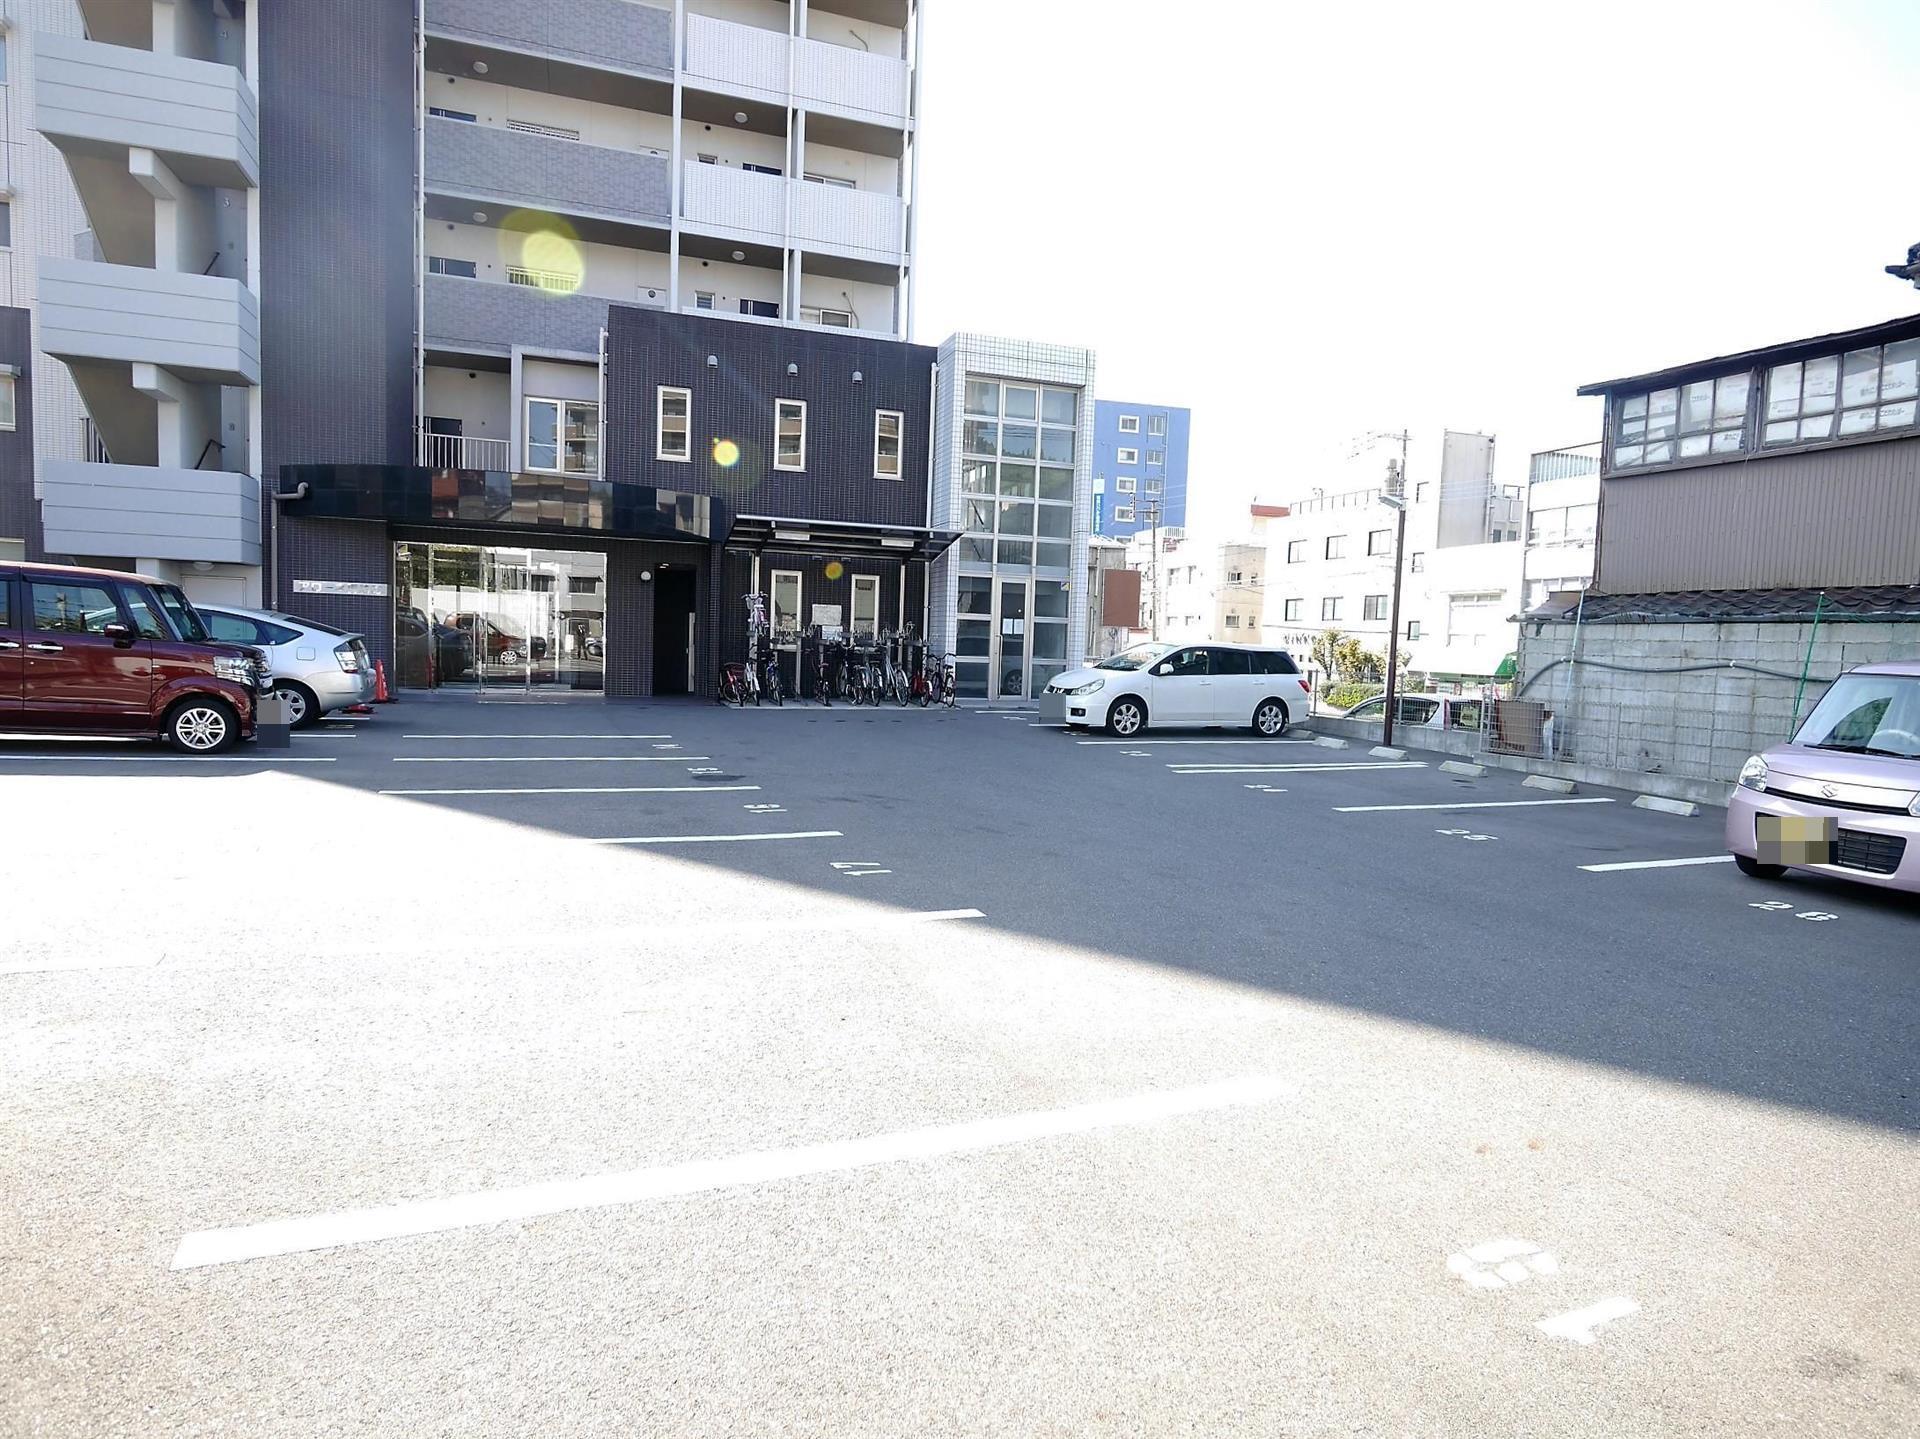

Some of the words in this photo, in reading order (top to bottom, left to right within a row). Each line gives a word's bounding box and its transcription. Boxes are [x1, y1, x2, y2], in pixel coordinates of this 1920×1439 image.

[743, 803, 788, 813] 16
[829, 862, 892, 876] 17
[1748, 900, 1840, 922] 26
